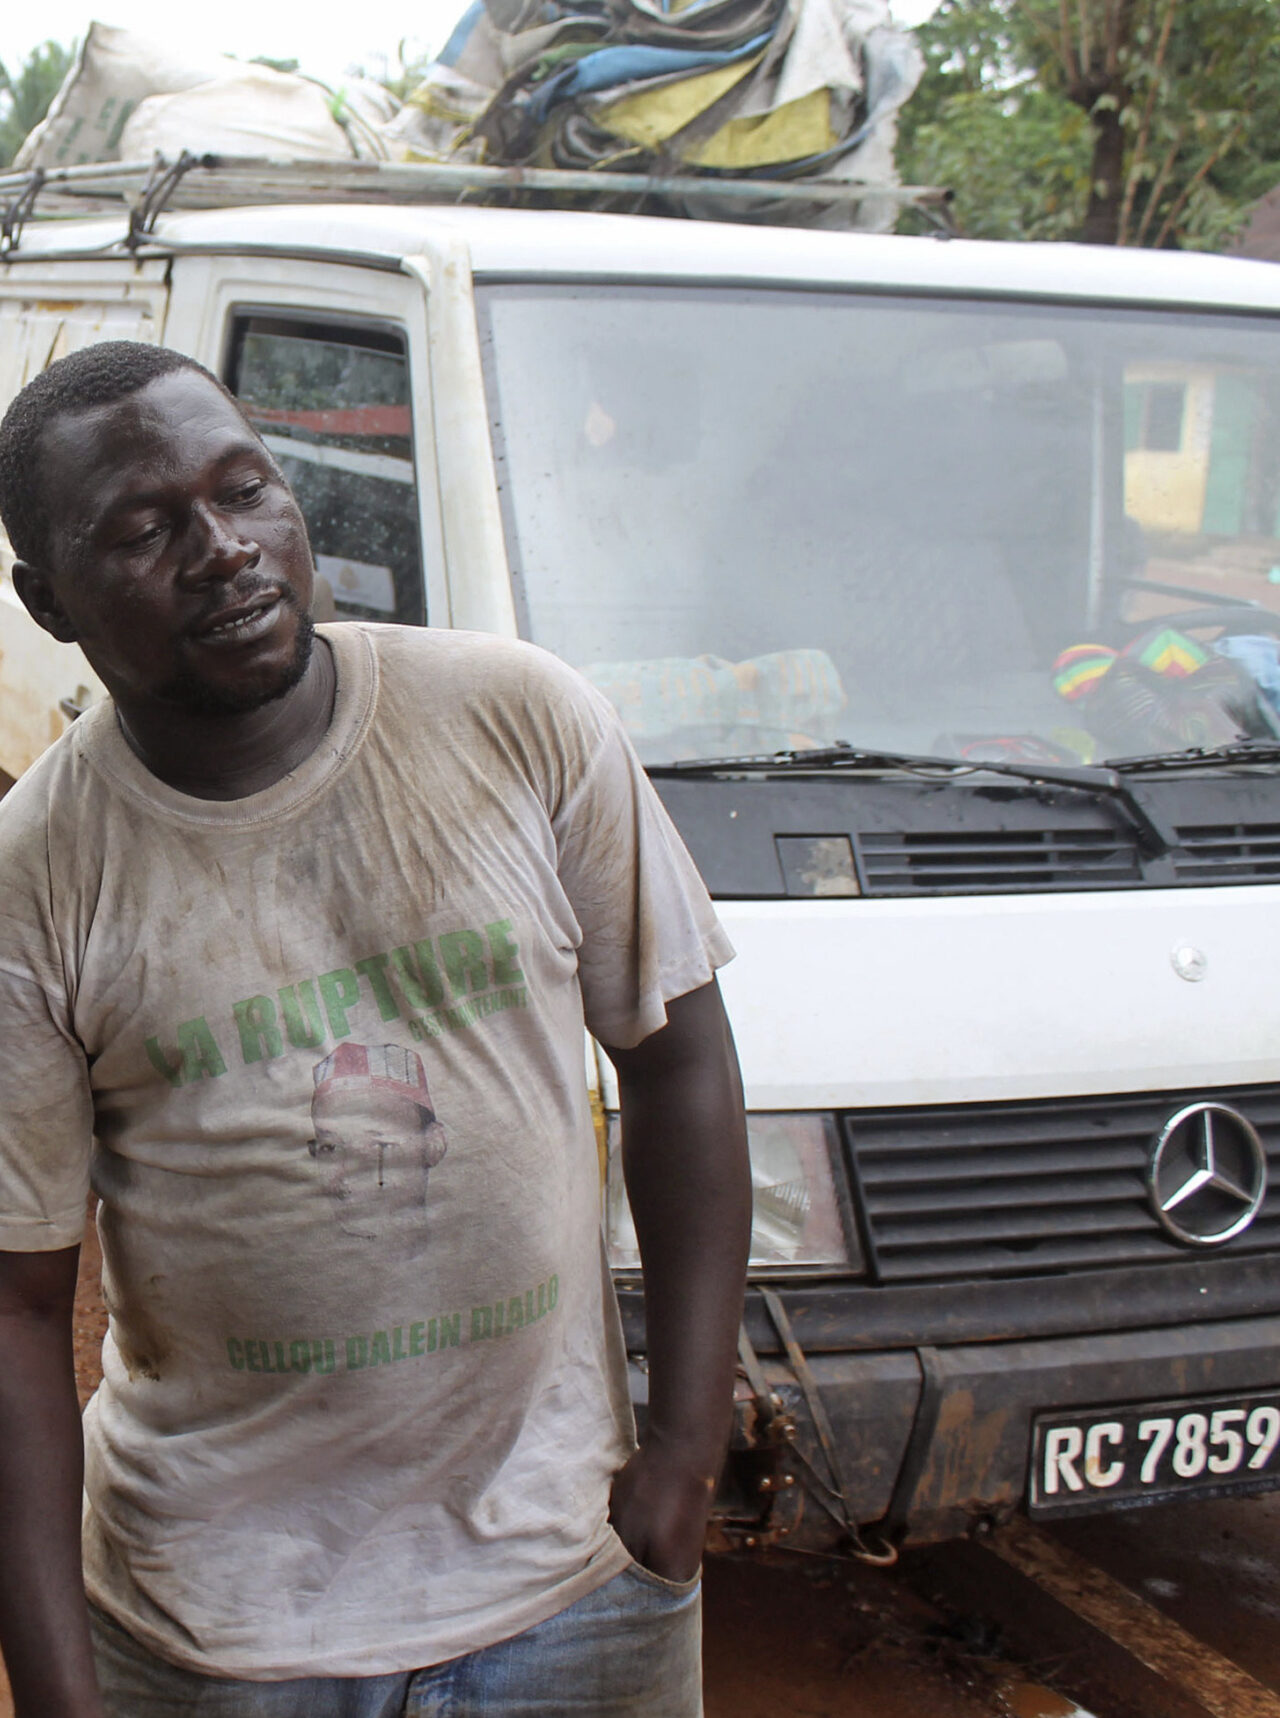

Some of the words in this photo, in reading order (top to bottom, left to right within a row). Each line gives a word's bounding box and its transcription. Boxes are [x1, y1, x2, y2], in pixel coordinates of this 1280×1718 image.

[145, 1015, 228, 1088] LA
[232, 918, 525, 1065] RUPTURE
[226, 1336, 336, 1376] CELLOU
[346, 1312, 462, 1371] DALEIN
[471, 1272, 559, 1343] DIALLO
[1044, 1421, 1126, 1495] RC
[1137, 1405, 1280, 1484] 7859
